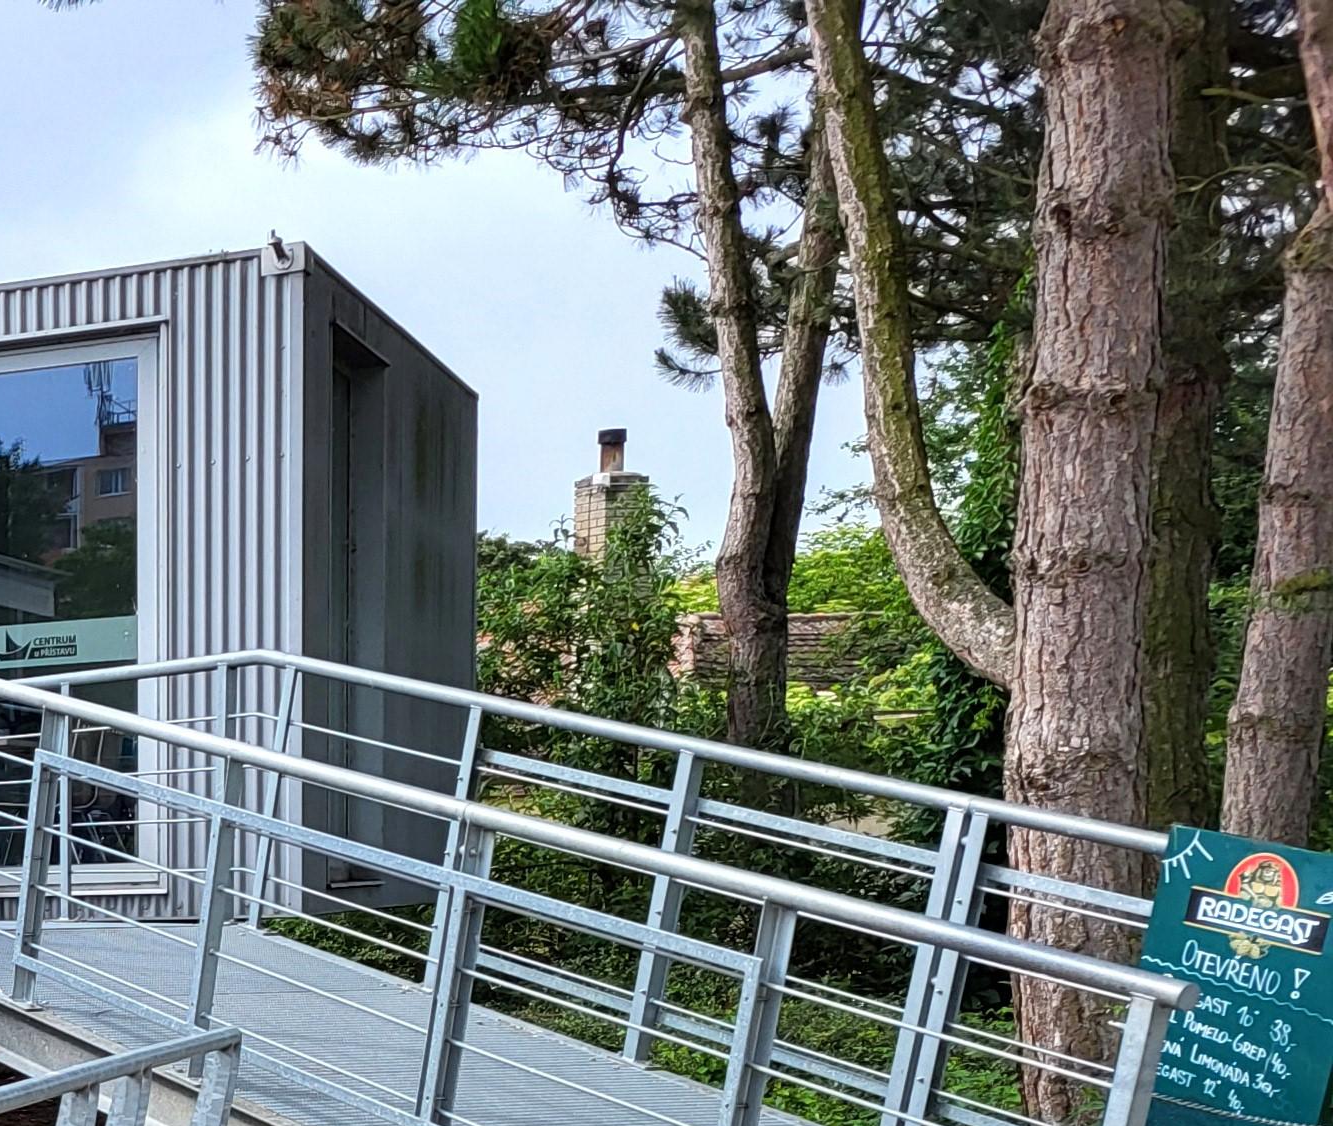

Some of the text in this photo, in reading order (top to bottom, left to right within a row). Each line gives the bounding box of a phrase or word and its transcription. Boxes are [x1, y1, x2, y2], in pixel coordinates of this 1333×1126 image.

[33, 634, 77, 647] CENTRUM
[1196, 896, 1320, 945] RADEGAST
[1181, 939, 1282, 995] OTEVŘENO
